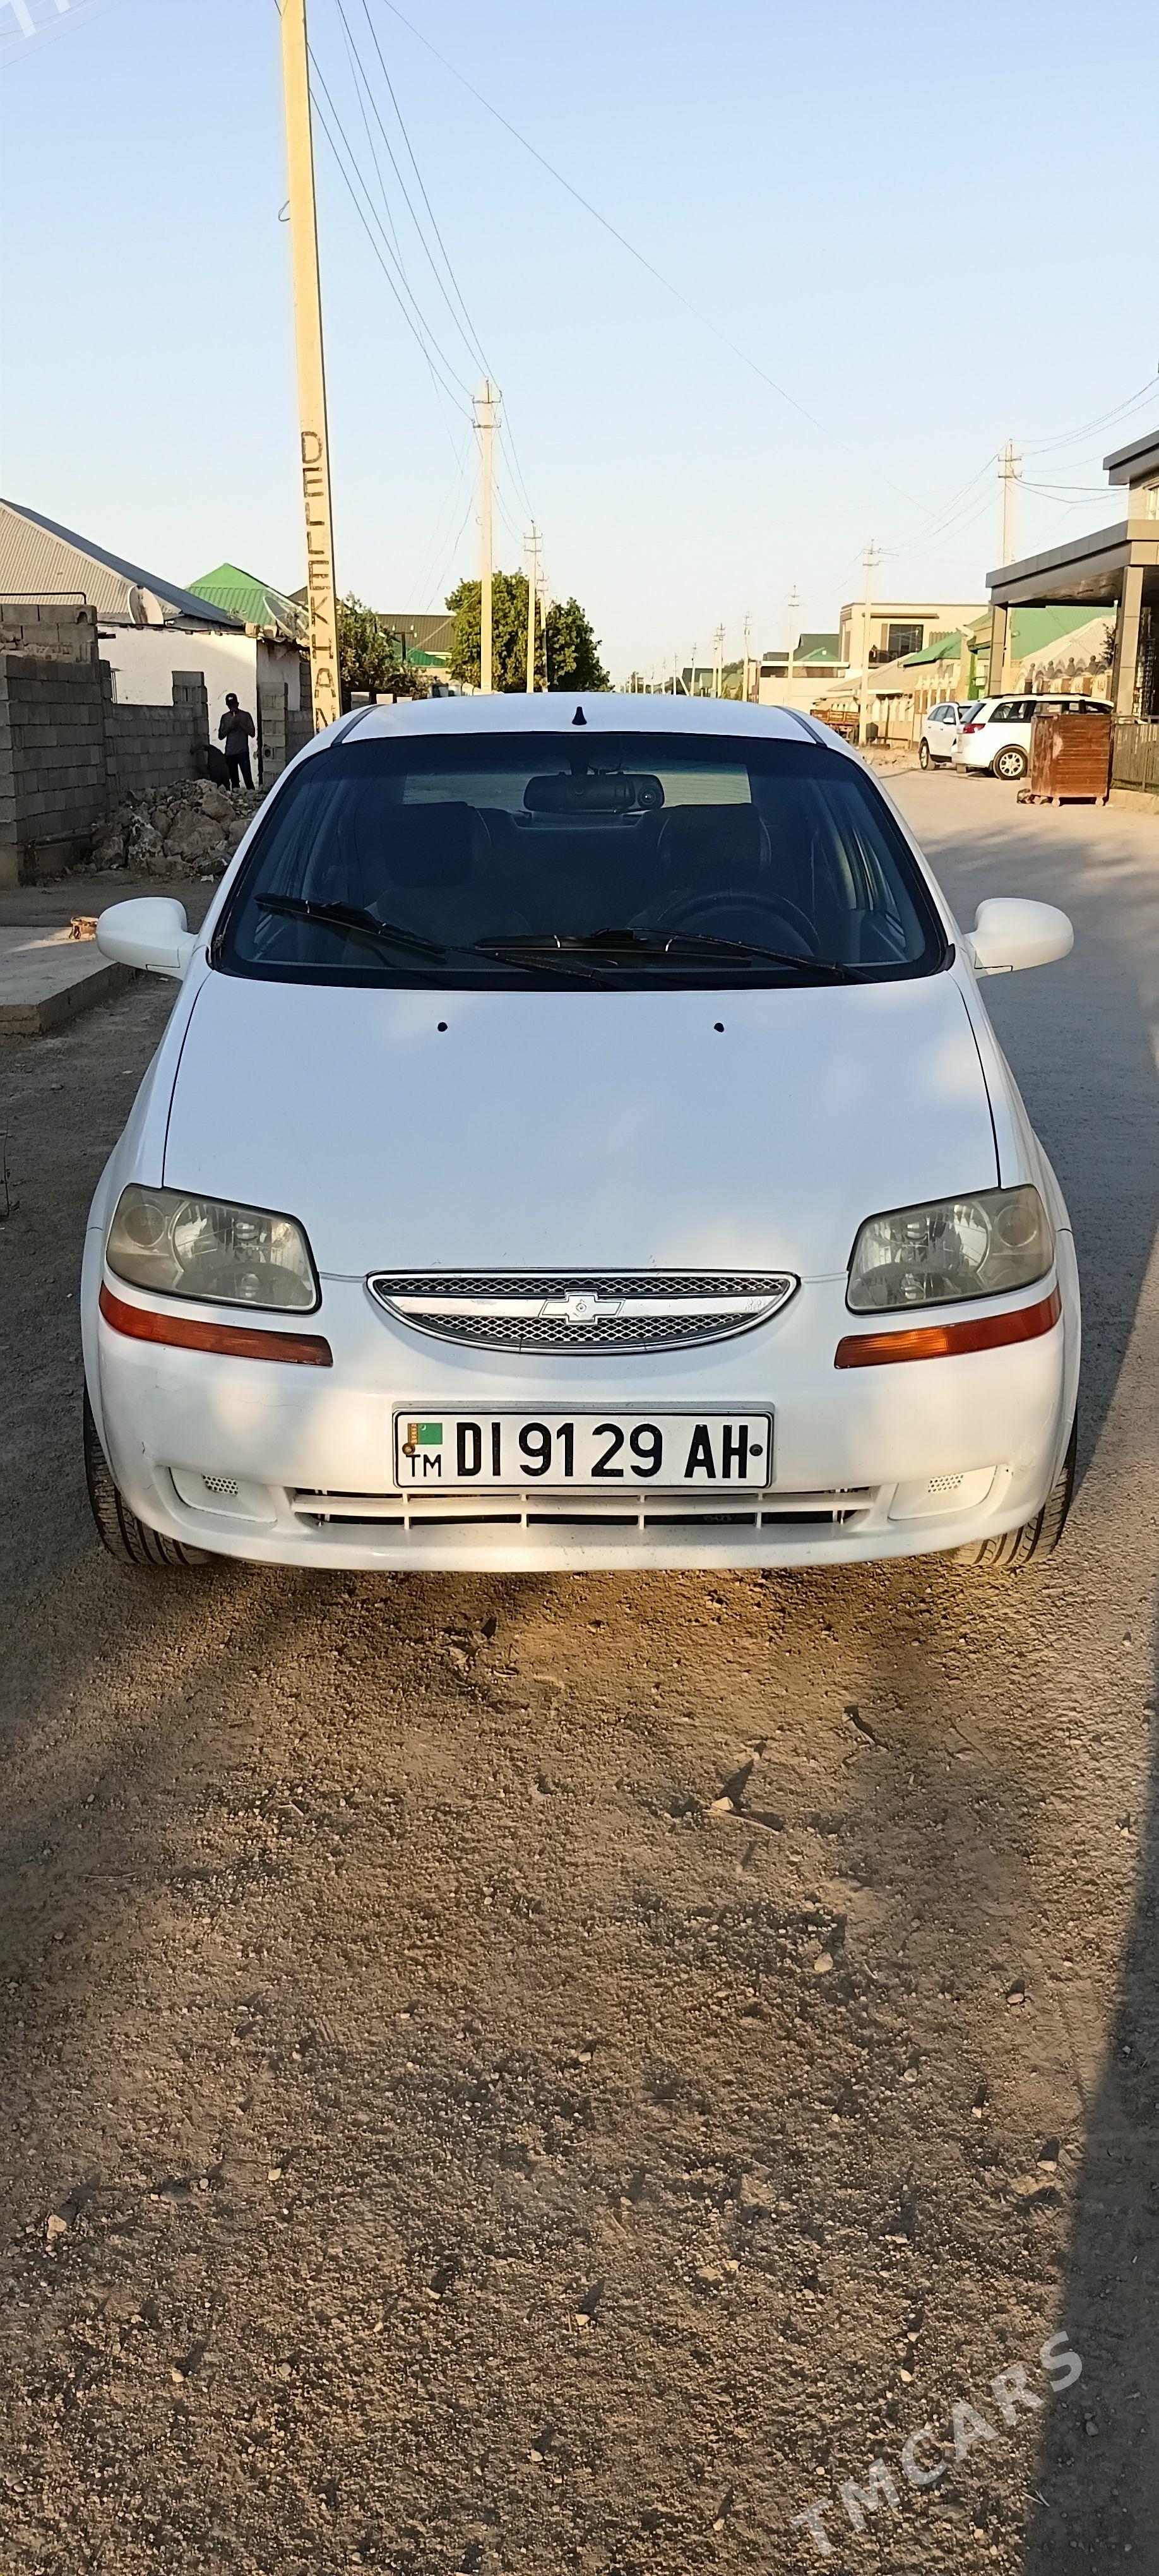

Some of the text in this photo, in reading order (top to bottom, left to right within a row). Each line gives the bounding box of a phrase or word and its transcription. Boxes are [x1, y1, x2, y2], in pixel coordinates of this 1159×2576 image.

[300, 431, 336, 734] DELLEKHAN
[406, 1454, 441, 1477] TM
[684, 1424, 749, 1479] AH
